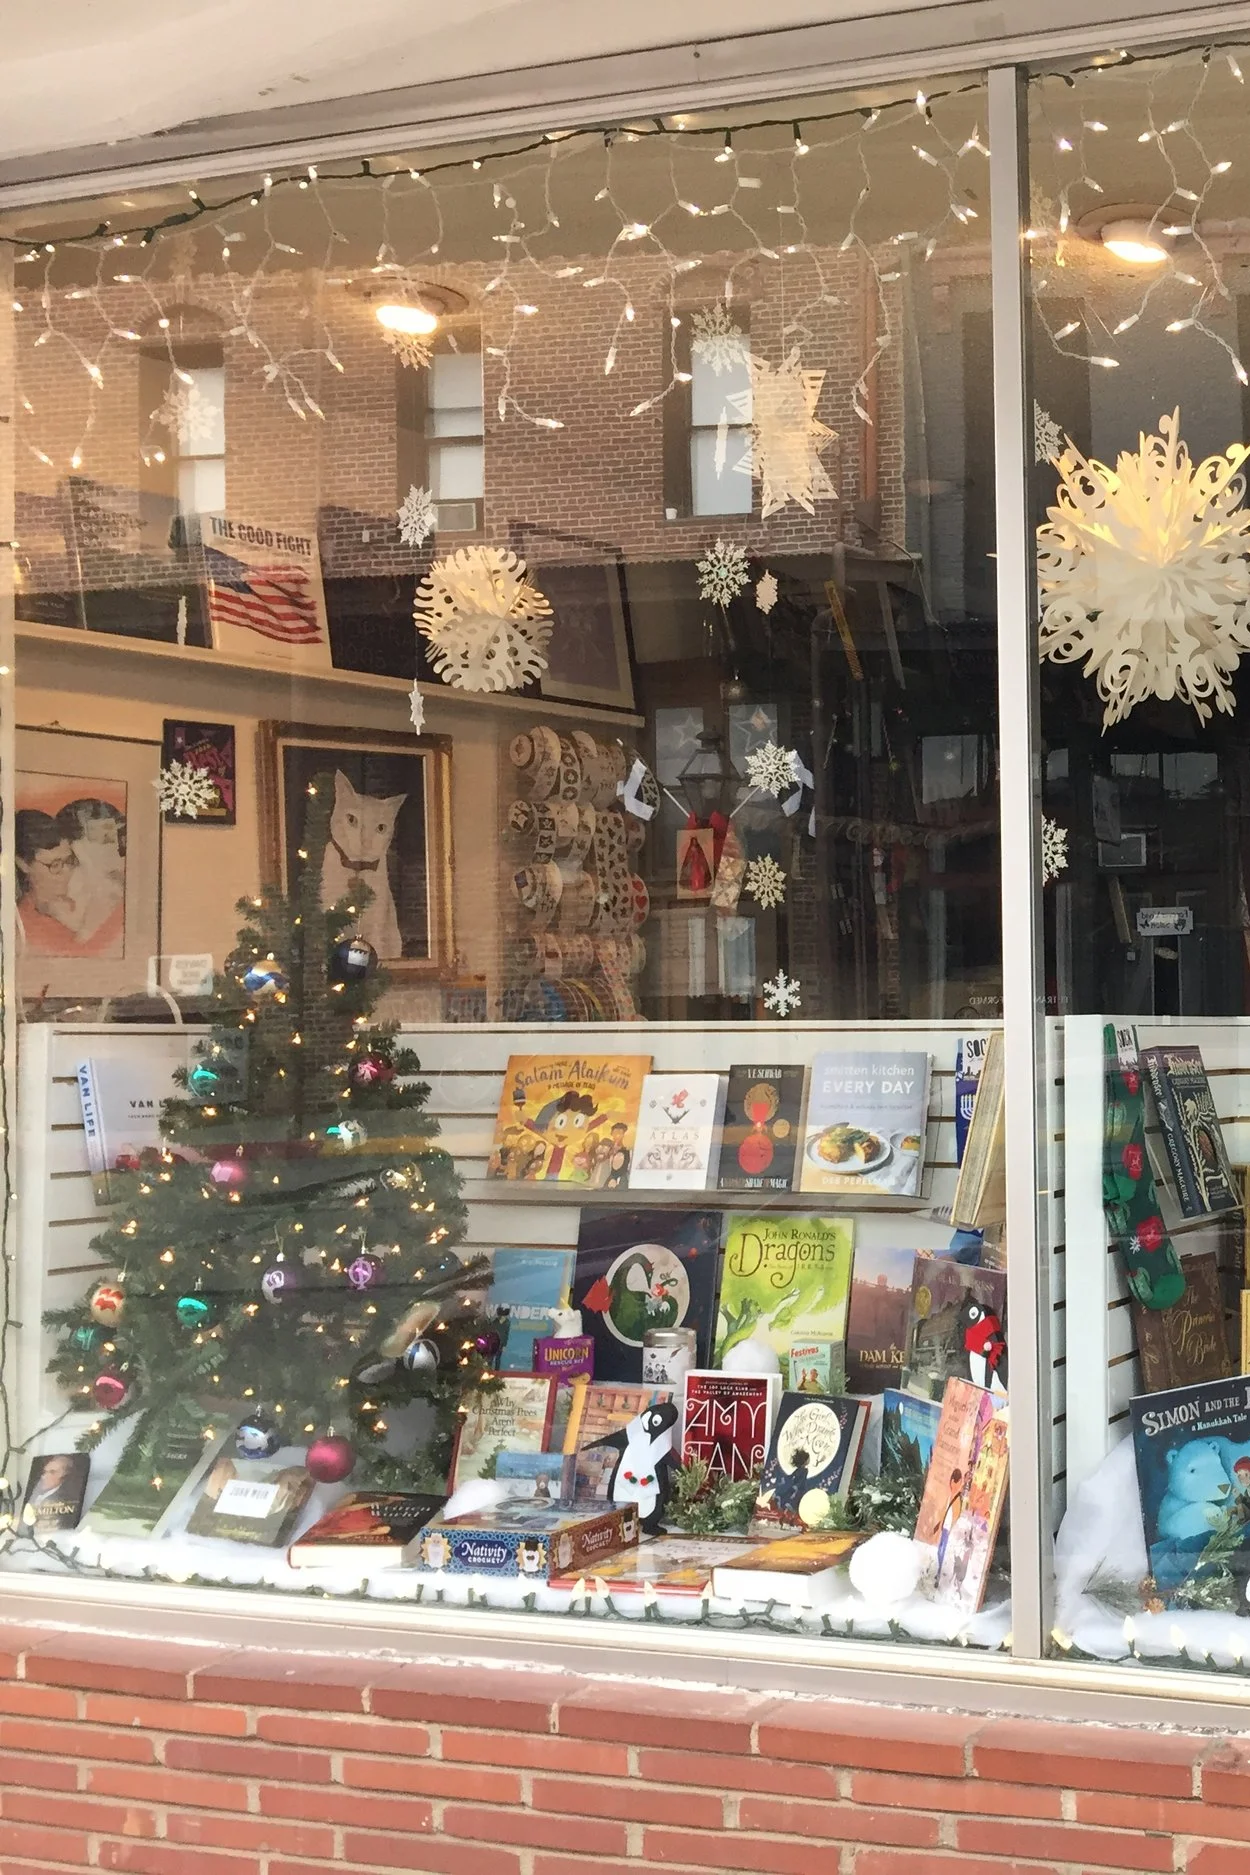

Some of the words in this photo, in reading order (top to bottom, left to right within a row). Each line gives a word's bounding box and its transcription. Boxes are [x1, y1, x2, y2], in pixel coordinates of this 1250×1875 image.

[209, 517, 236, 539] THE
[238, 523, 274, 547] GOOD
[276, 531, 312, 556] FIGHT
[515, 1066, 563, 1089] Salam
[568, 1059, 630, 1090] Alaikum
[872, 1064, 914, 1076] kitchen
[78, 1065, 90, 1097] VAN
[823, 1081, 875, 1093] EVERY
[881, 1081, 914, 1094] DAY
[83, 1102, 96, 1138] LIFE
[763, 1229, 788, 1241] JOHN
[791, 1229, 836, 1240] RONALD'S
[729, 1233, 836, 1289] Dragons
[544, 1347, 589, 1361] UNICORN
[860, 1349, 886, 1363] DAM
[472, 1404, 514, 1418] Christmas
[685, 1399, 767, 1438] AMY
[809, 1407, 832, 1424] Girl
[1142, 1401, 1200, 1437] SIMON
[1205, 1400, 1221, 1413] AND
[1224, 1397, 1240, 1409] THE
[808, 1422, 837, 1440] Drank
[1197, 1418, 1232, 1431] Hanukkah
[1232, 1413, 1248, 1424] Tale
[801, 1434, 830, 1454] Moon
[684, 1442, 766, 1482] TAN
[581, 1526, 613, 1548] Nativity
[461, 1543, 512, 1563] Nativity
